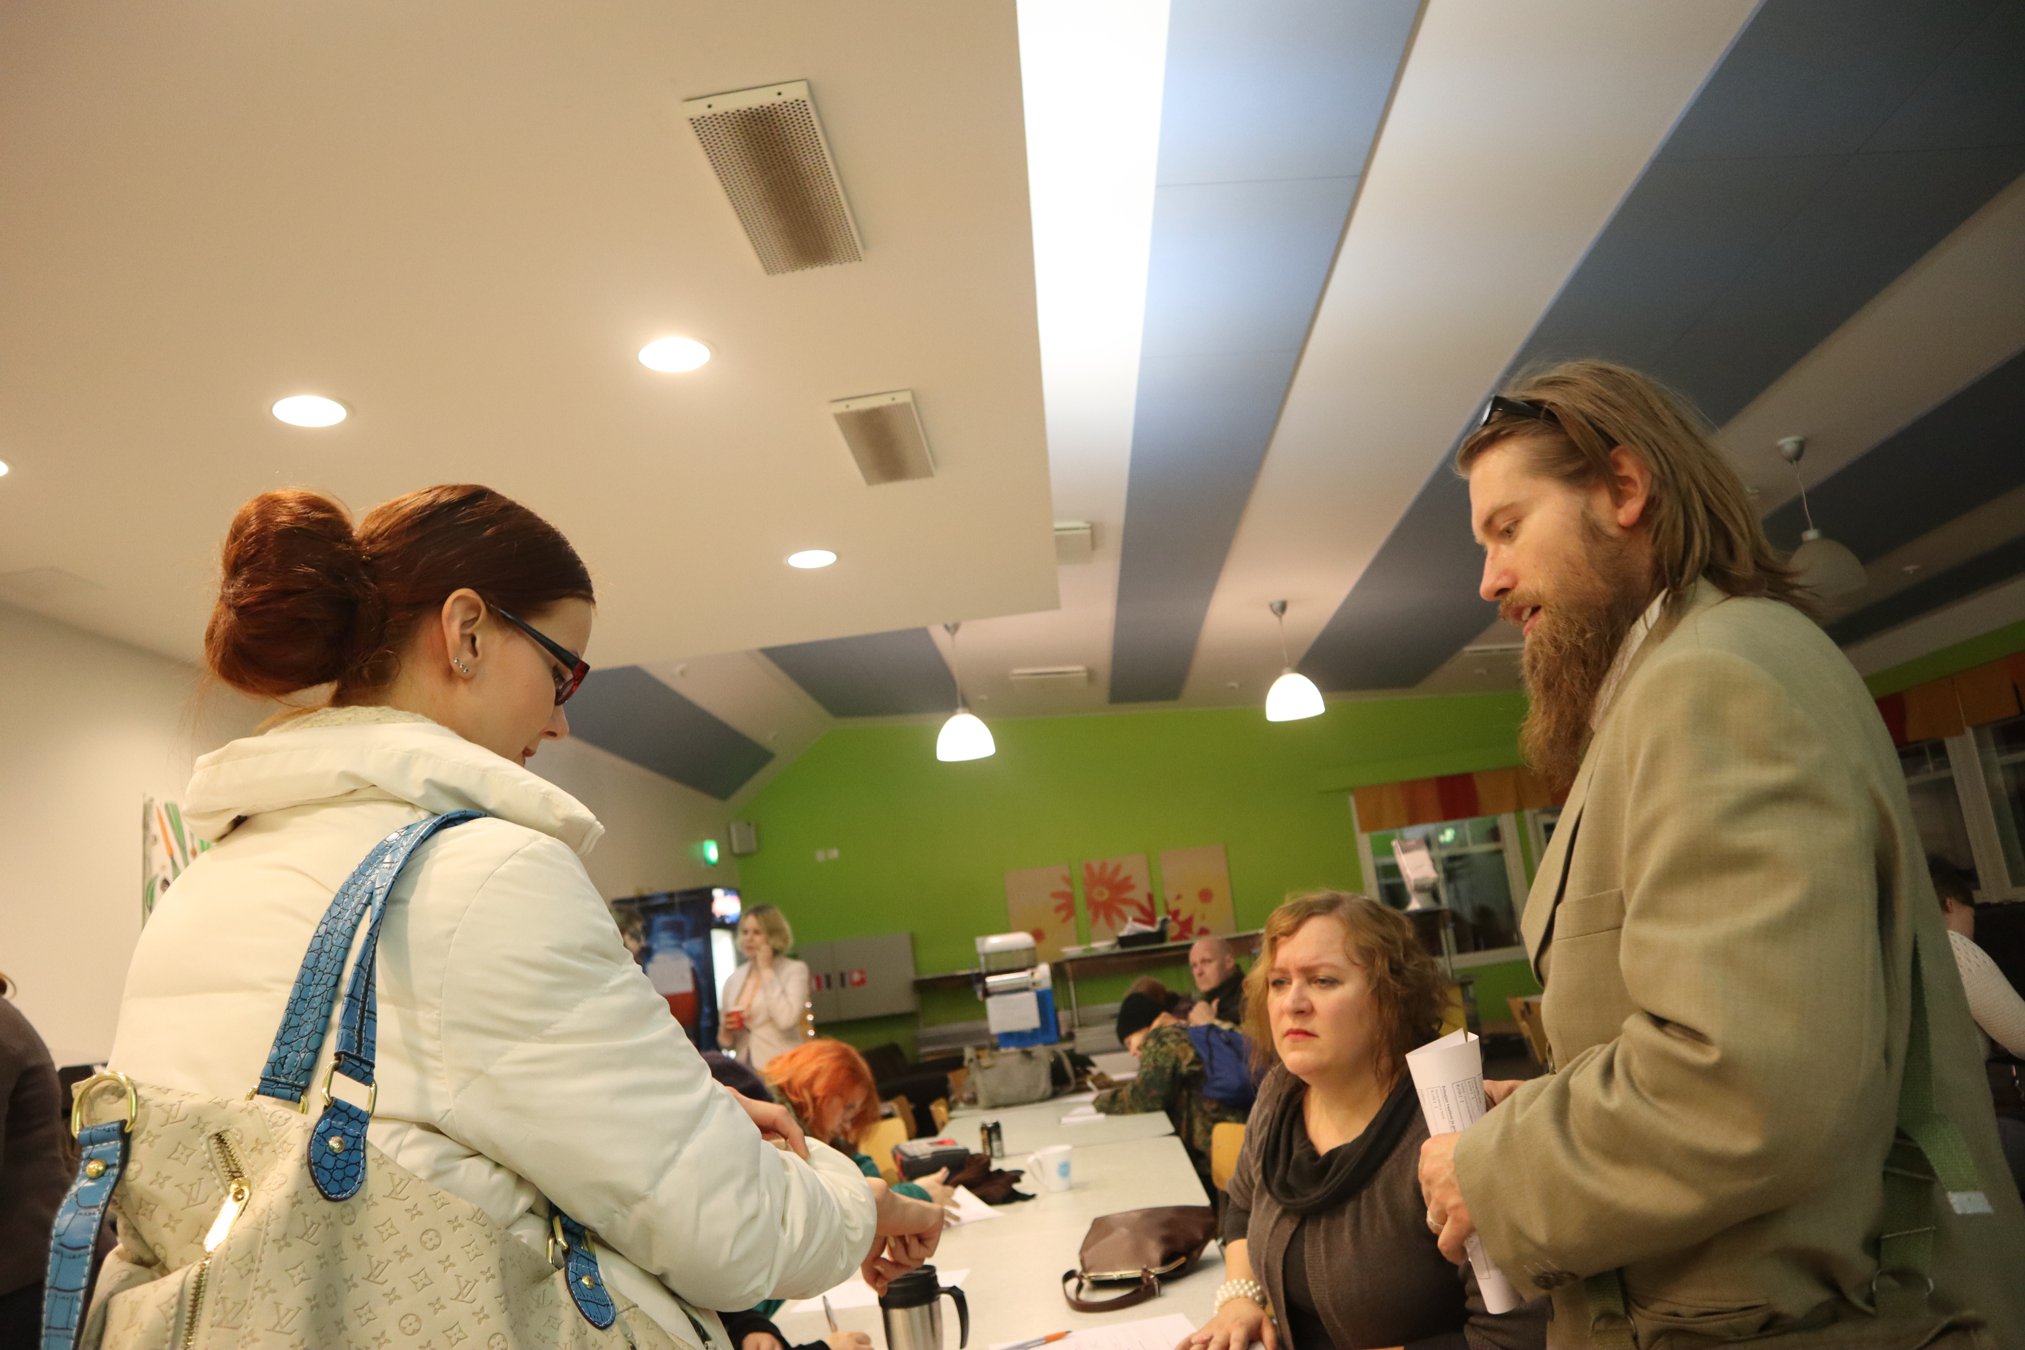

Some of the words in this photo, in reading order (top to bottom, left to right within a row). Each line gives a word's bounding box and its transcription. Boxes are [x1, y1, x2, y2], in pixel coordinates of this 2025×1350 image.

[155, 1100, 189, 1127] LV
[175, 1178, 210, 1210] LV
[382, 1172, 413, 1201] LV
[362, 1254, 393, 1285] LV
[450, 1274, 480, 1304] LV
[265, 1302, 302, 1335] LV
